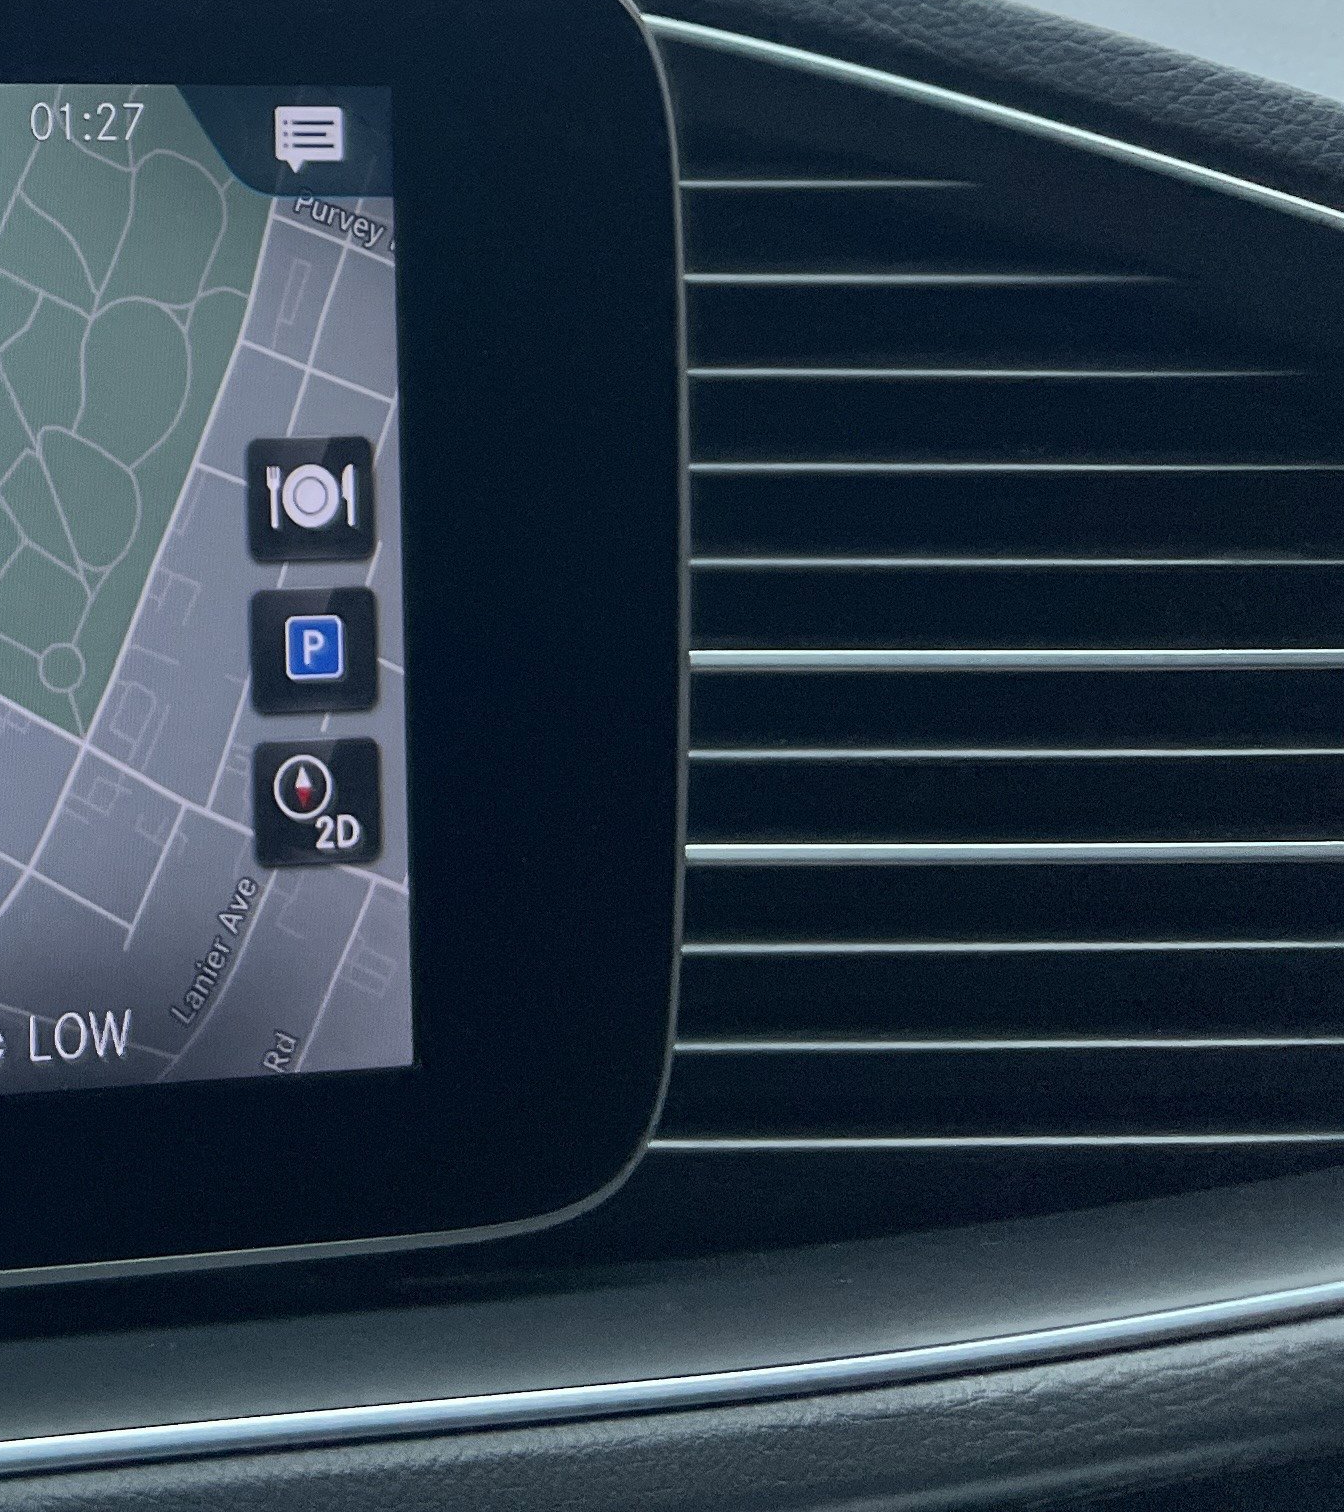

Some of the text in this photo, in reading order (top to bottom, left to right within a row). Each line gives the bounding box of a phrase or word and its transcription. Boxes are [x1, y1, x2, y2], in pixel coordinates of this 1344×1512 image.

[28, 101, 146, 142] 01:27
[302, 628, 326, 666] P
[314, 813, 362, 851] 2D
[169, 876, 258, 1026] Lanier Ave
[28, 1007, 133, 1063] LOW
[262, 1030, 299, 1073] Rd
